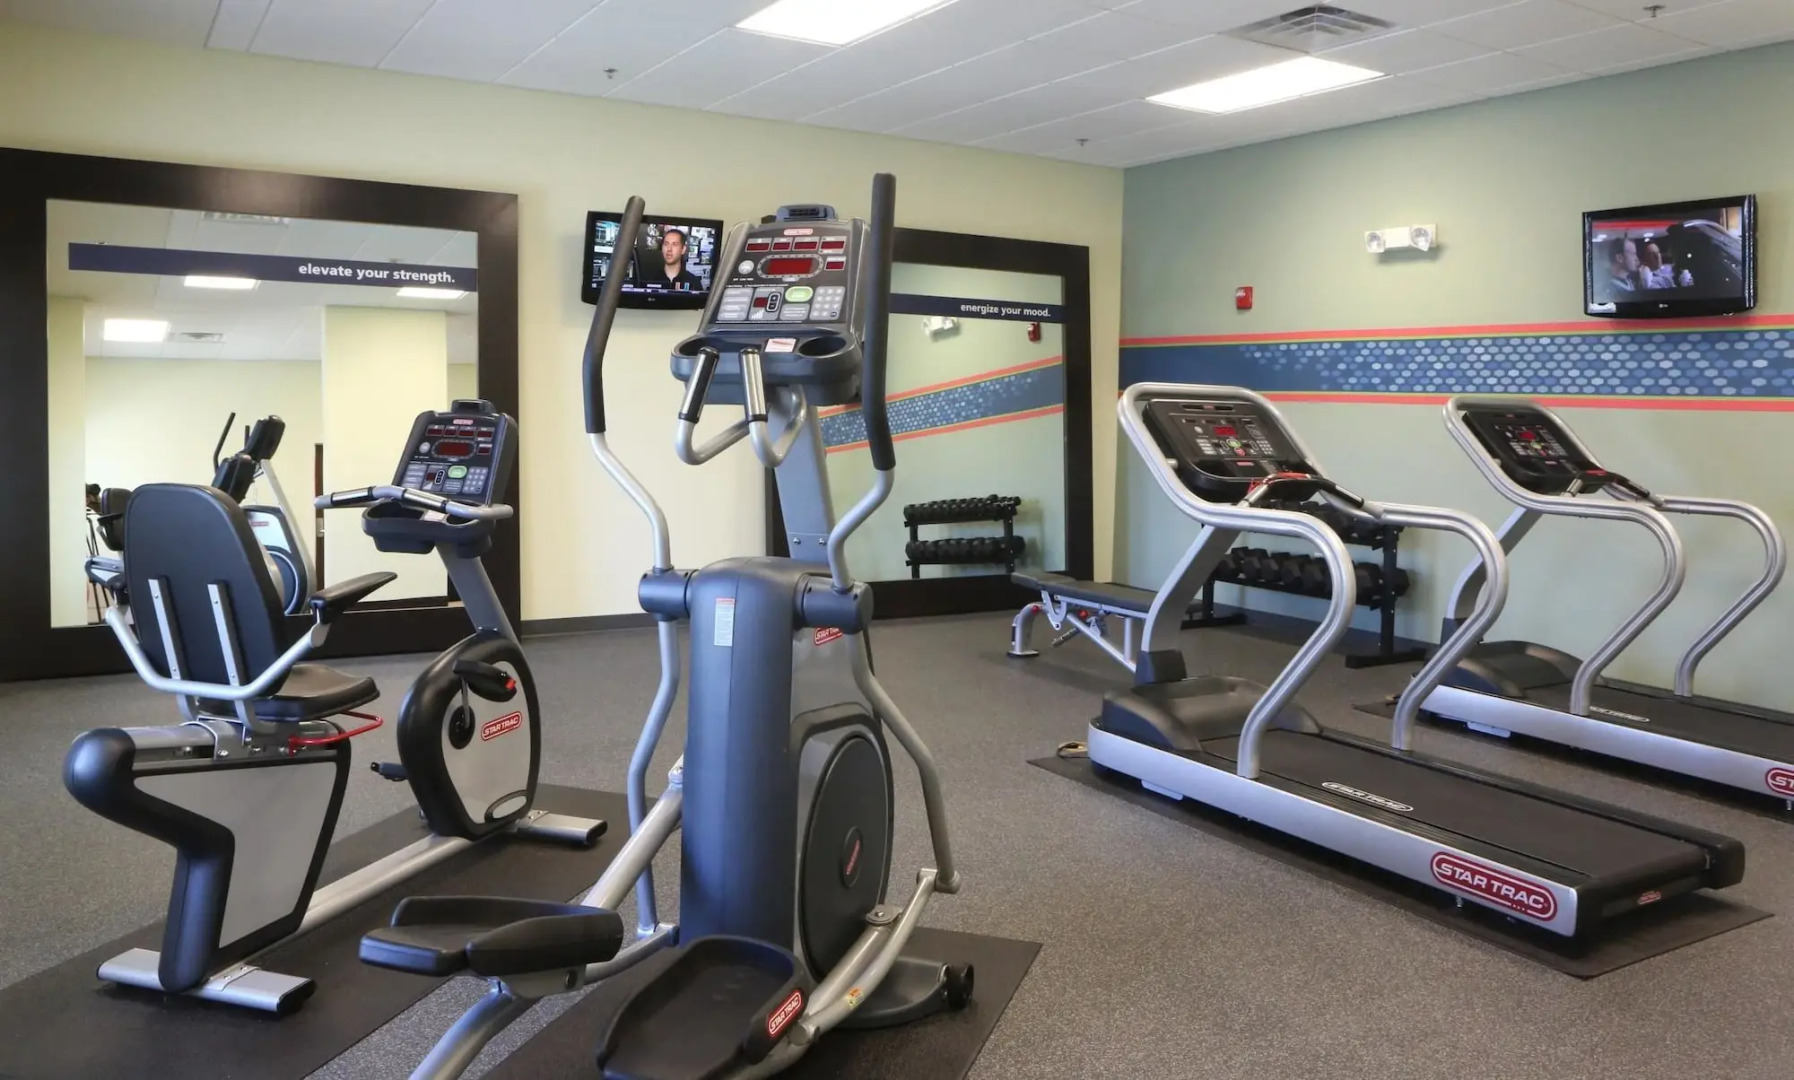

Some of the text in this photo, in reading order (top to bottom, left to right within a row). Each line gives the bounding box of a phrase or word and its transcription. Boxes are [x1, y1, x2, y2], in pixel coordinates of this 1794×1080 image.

[298, 263, 456, 284] elevate your strength.
[960, 304, 1051, 317] energize your mood.
[484, 716, 519, 735] STAR TRAC
[1435, 862, 1546, 909] STAR TRAC
[770, 996, 799, 1029] STAR TRAC
